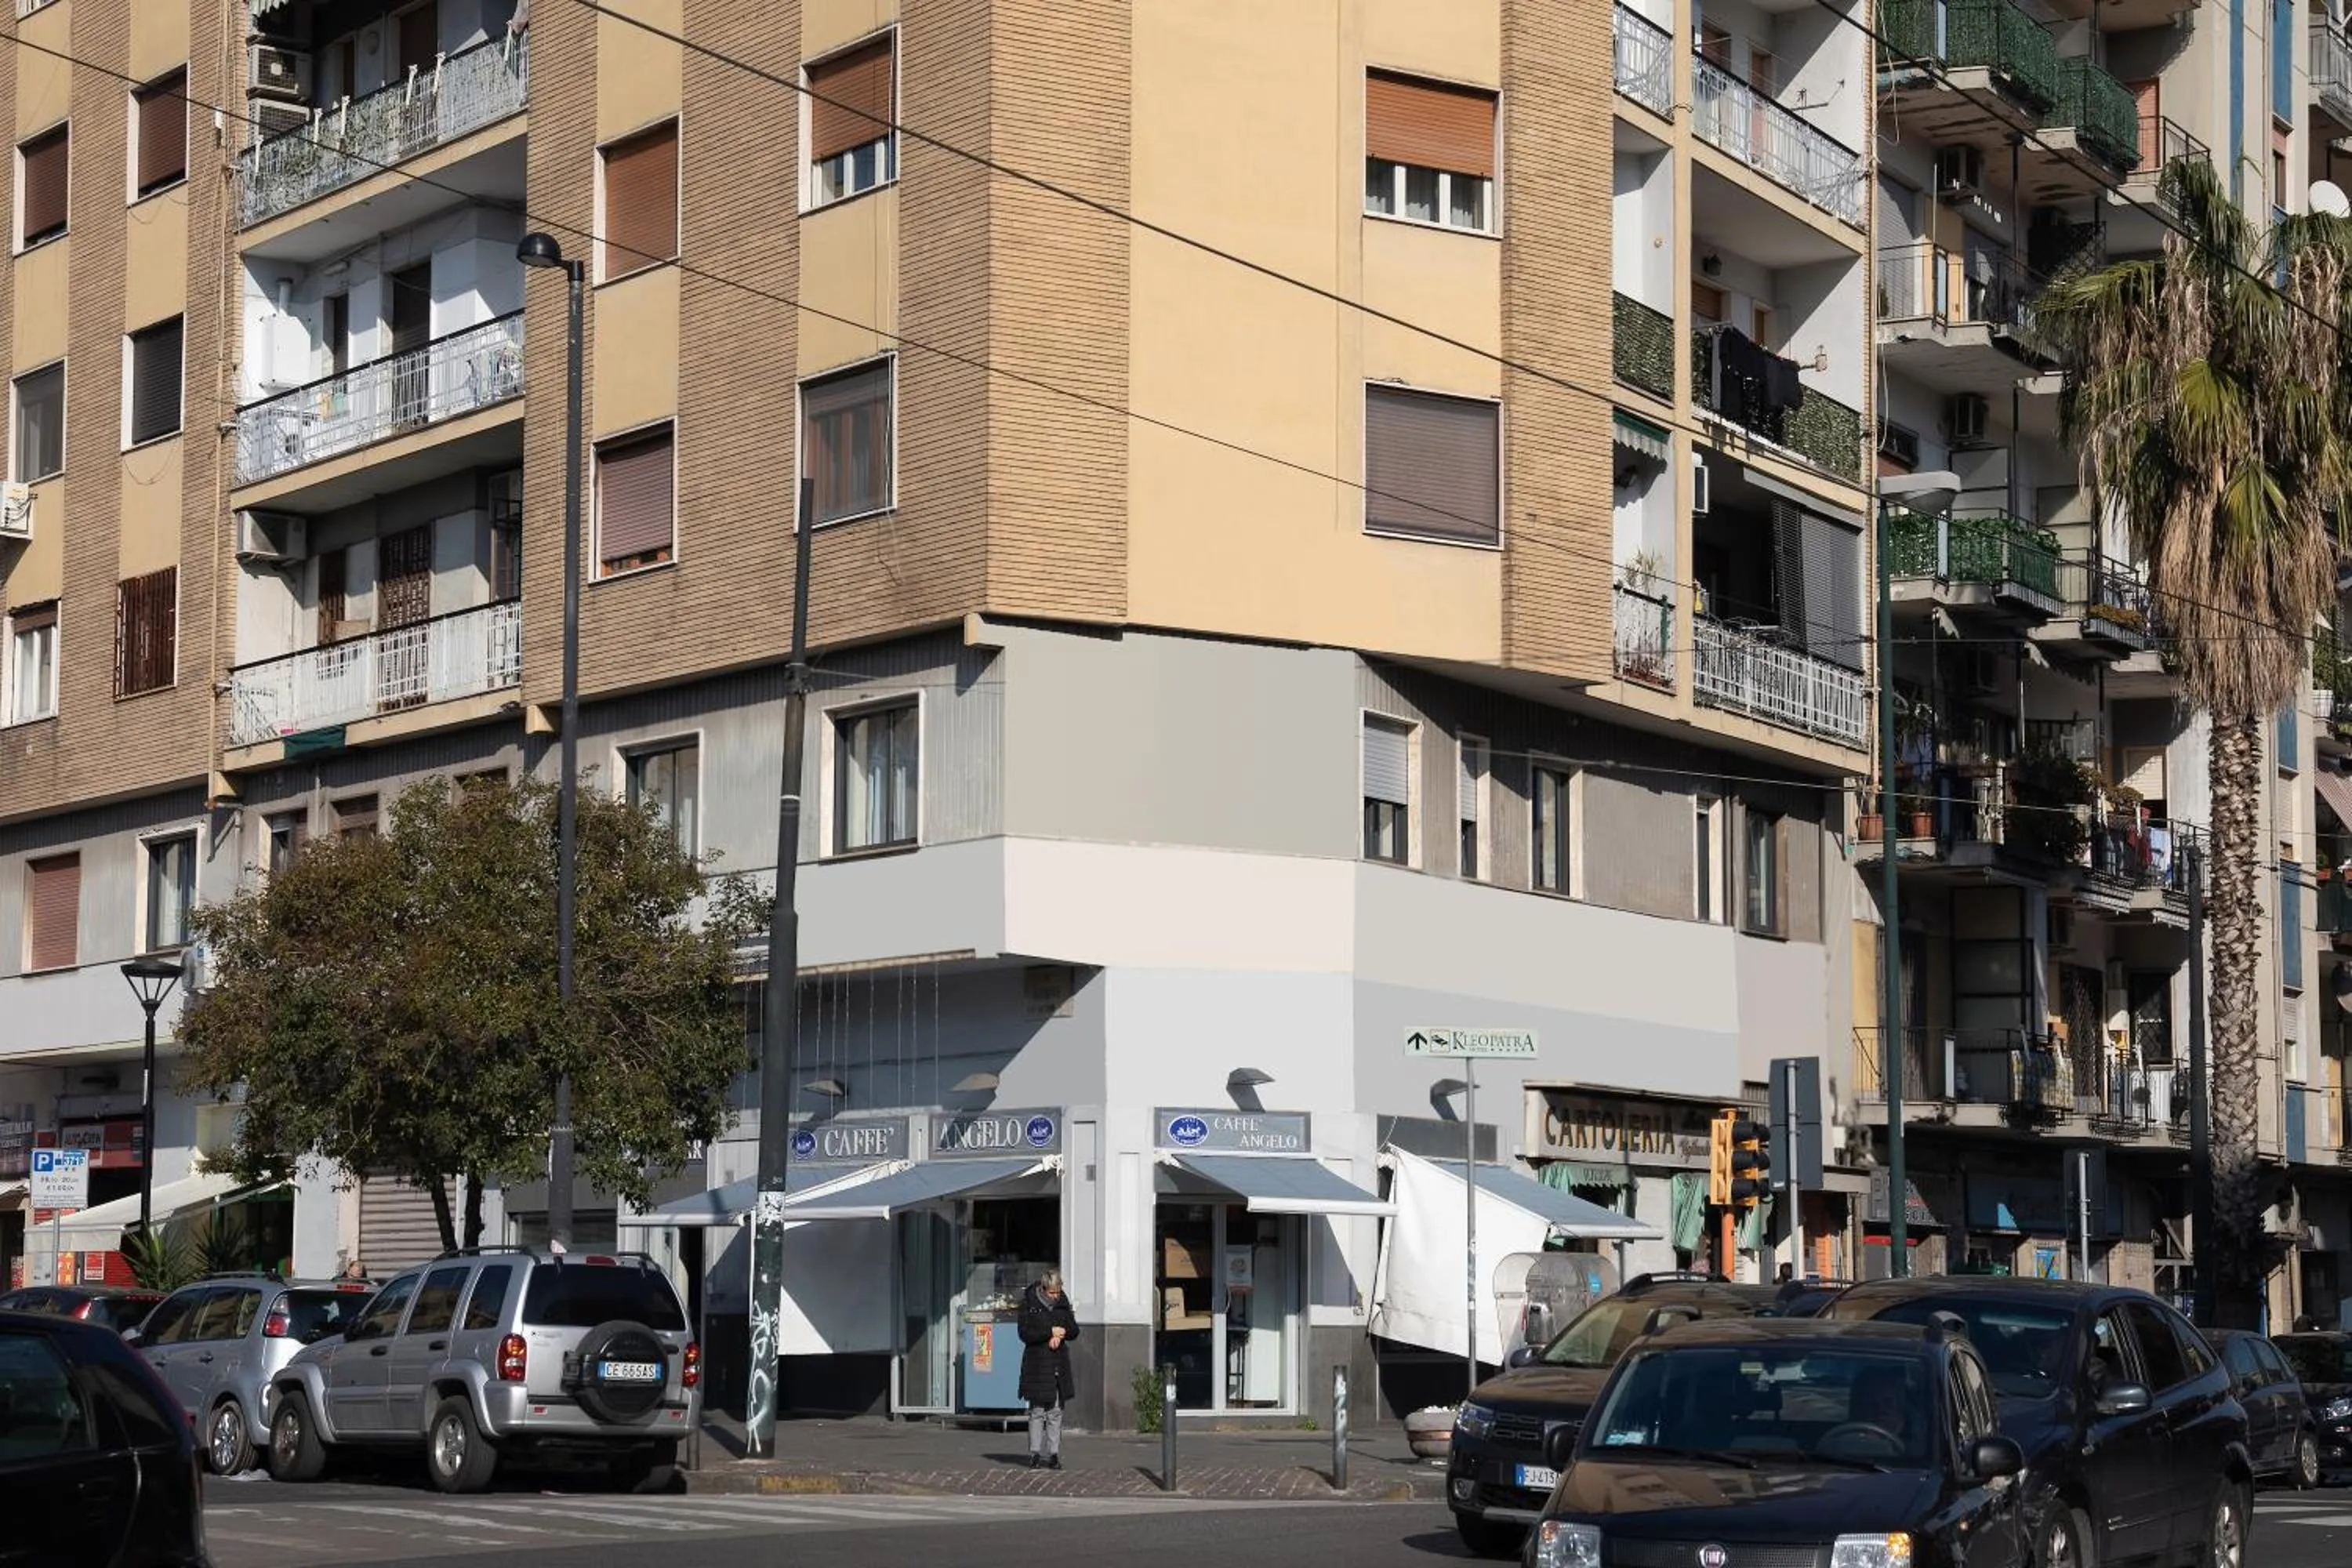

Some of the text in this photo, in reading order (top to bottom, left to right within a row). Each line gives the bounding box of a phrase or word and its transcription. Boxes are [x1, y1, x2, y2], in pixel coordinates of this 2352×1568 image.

[1453, 1031, 1534, 1052] KLEOPATRA
[935, 1119, 1022, 1151] ANGELO
[1545, 1105, 1675, 1155] CARTOLERIA
[1240, 1134, 1298, 1149] ANGELO
[38, 1153, 50, 1171] P
